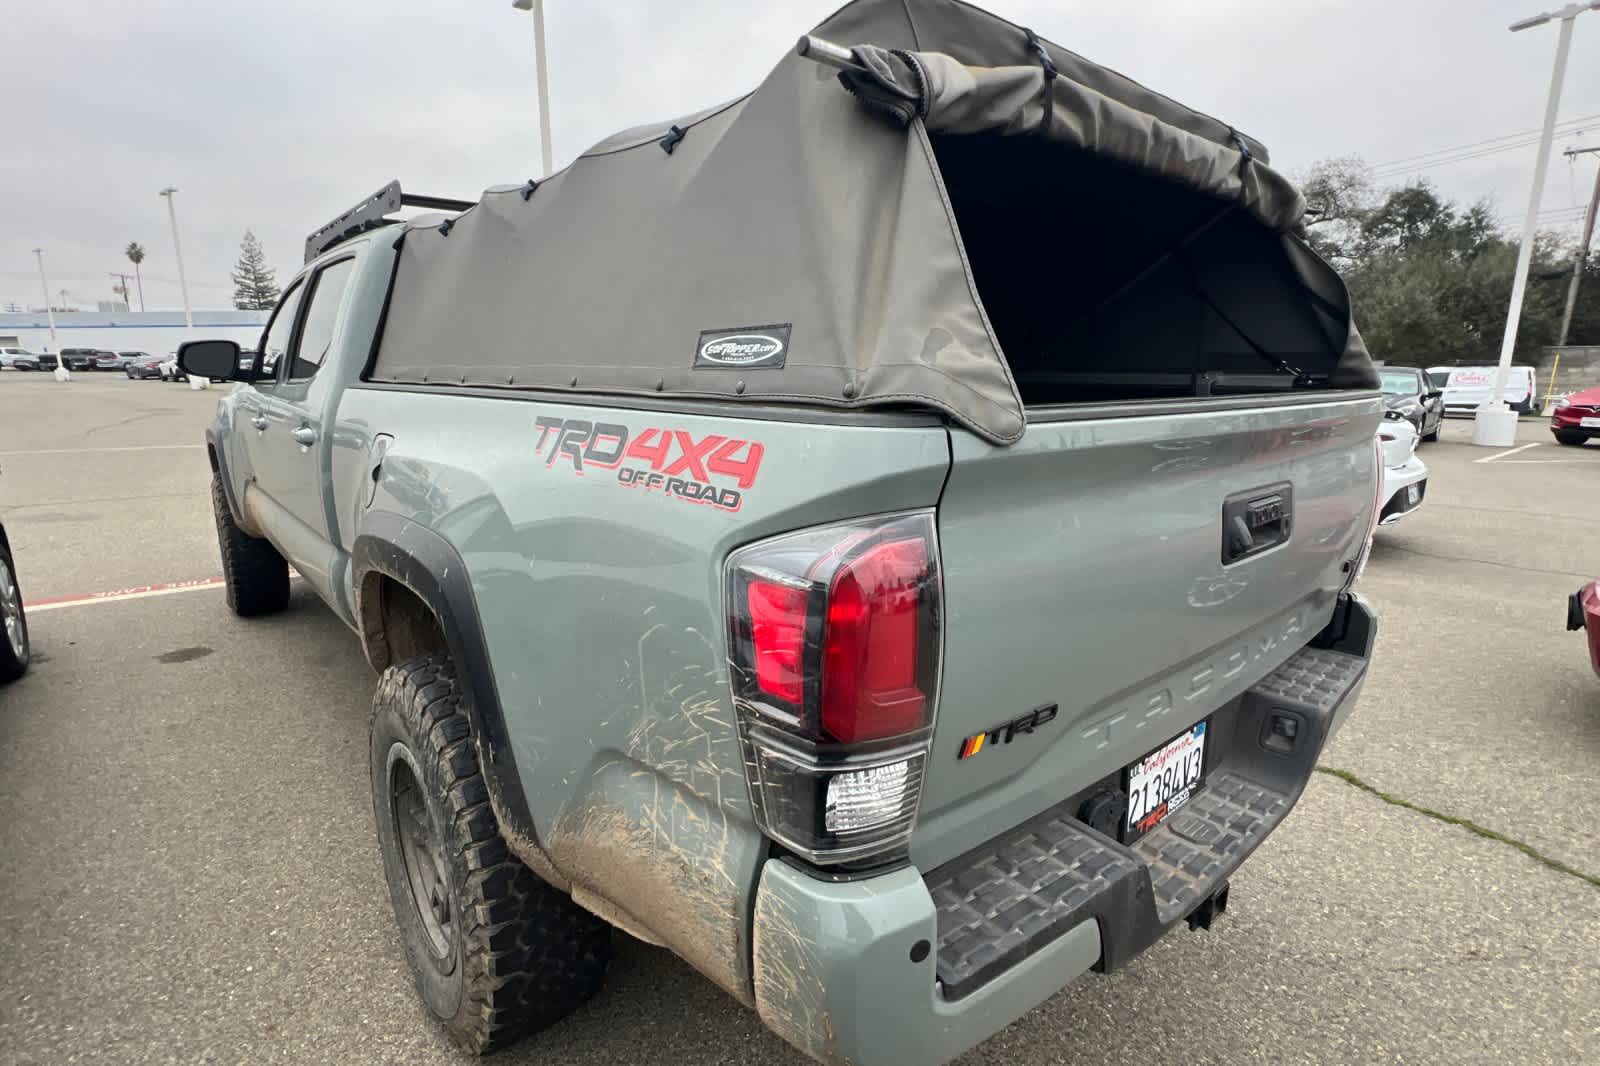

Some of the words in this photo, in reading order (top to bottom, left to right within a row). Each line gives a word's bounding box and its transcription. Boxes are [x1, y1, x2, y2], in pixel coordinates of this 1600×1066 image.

[535, 415, 630, 477] TRD
[617, 467, 664, 492] OFF
[664, 478, 744, 513] ROAD
[984, 703, 1058, 745] TRD
[1128, 746, 1201, 830] 21384V3
